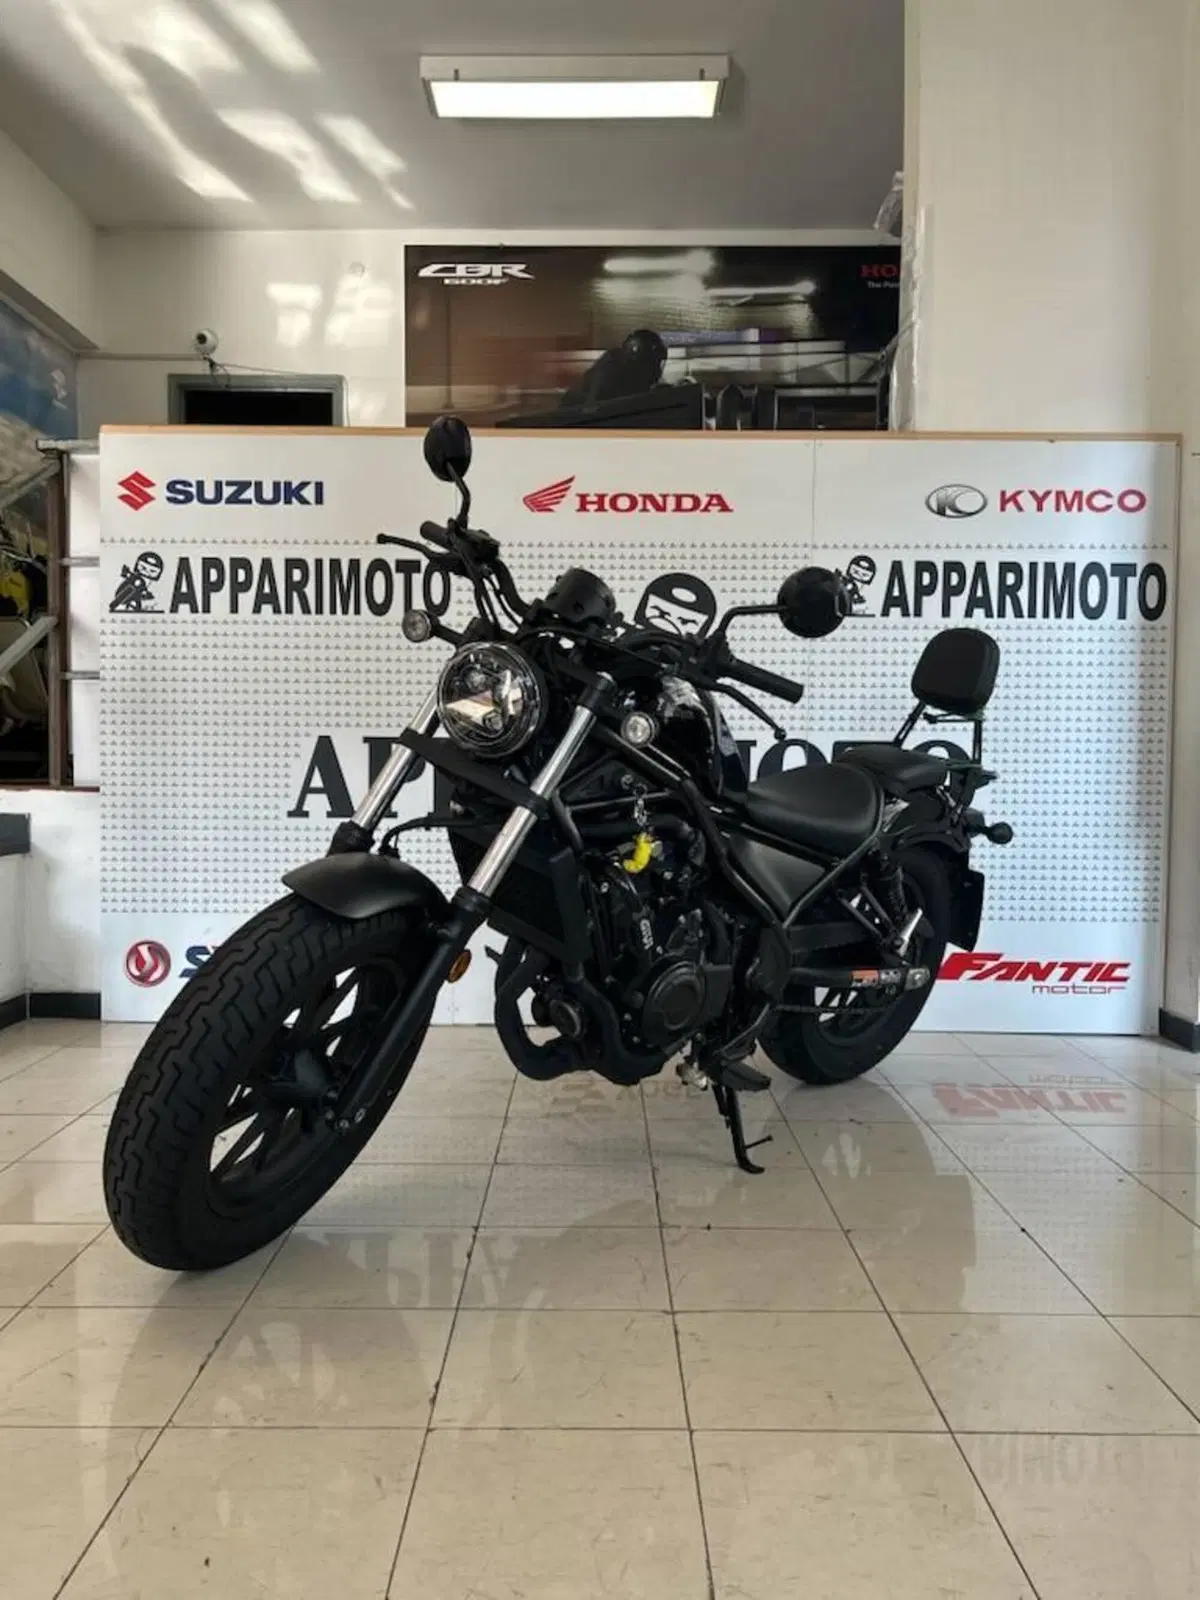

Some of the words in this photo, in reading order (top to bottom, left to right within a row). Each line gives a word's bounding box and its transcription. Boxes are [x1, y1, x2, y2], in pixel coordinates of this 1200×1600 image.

[418, 263, 535, 279] CBR
[860, 263, 899, 278] HO
[165, 479, 325, 506] SUZUKI
[575, 492, 734, 513] HONDA
[999, 488, 1147, 513] KYMCO
[169, 556, 451, 617] APPARIMOTO
[880, 559, 1168, 622] APPARIMOTO
[935, 952, 1132, 982] FANTIC
[1032, 984, 1126, 995] motor
